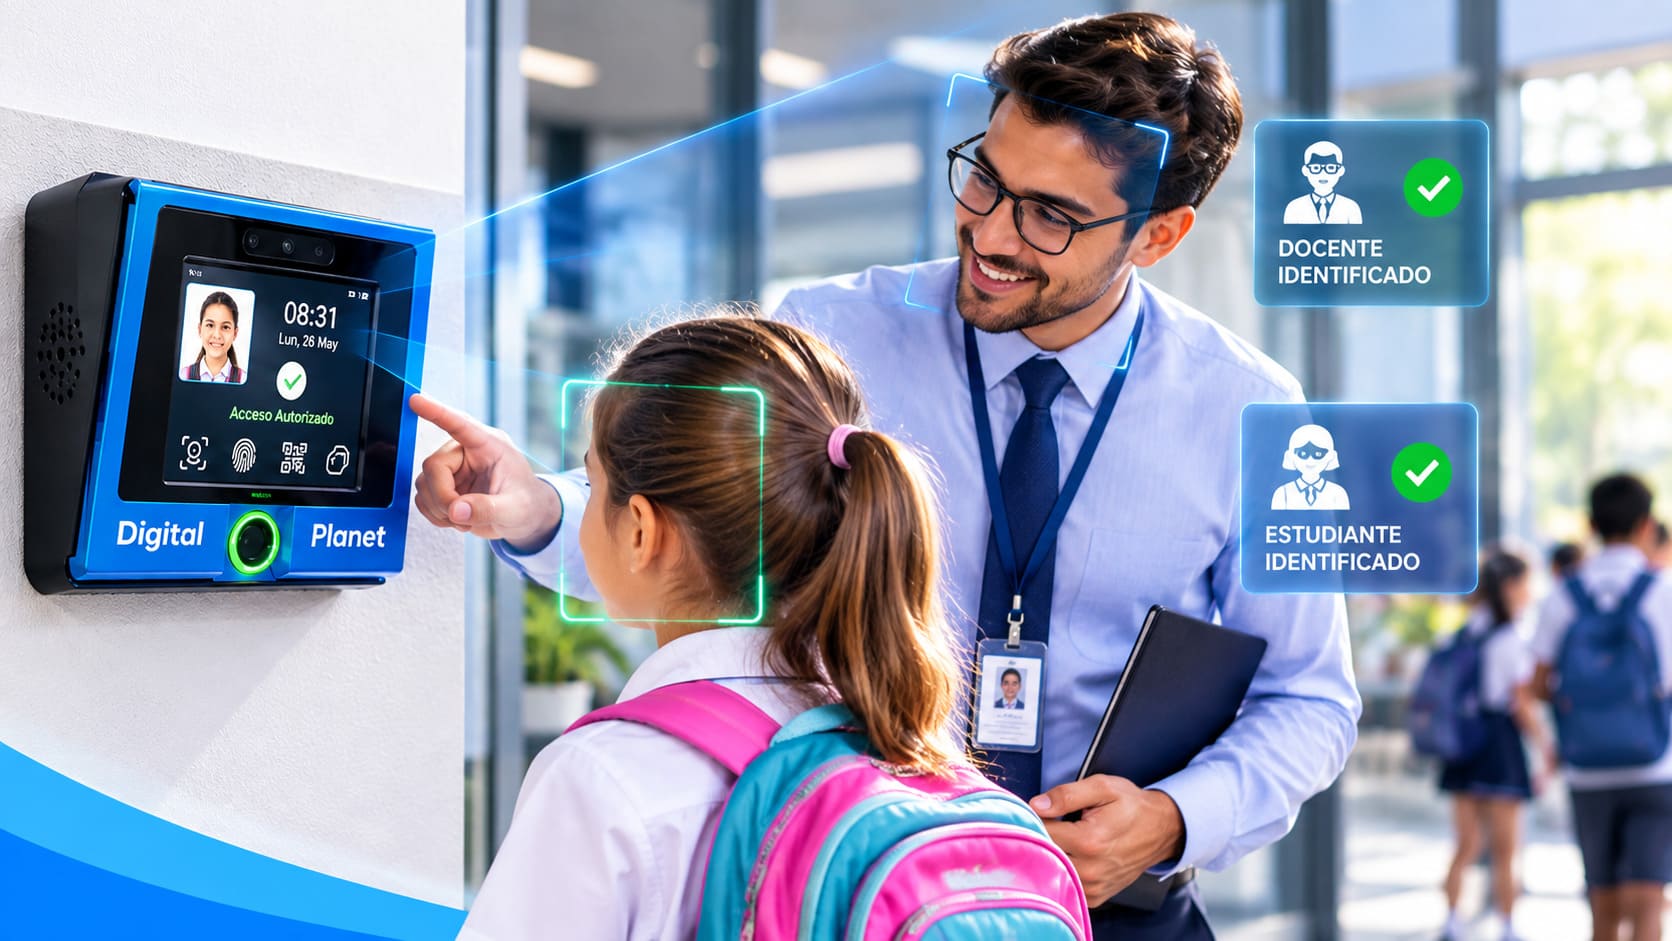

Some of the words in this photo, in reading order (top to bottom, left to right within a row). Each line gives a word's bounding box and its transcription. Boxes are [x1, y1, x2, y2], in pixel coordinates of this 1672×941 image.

[283, 301, 337, 329] 08:31
[279, 332, 300, 350] Lun,
[302, 335, 315, 349] 26
[317, 336, 339, 353] May
[229, 406, 273, 422] Acceso
[275, 409, 334, 426] Autorizado
[116, 520, 204, 552] Digital
[311, 523, 386, 548] Planet
